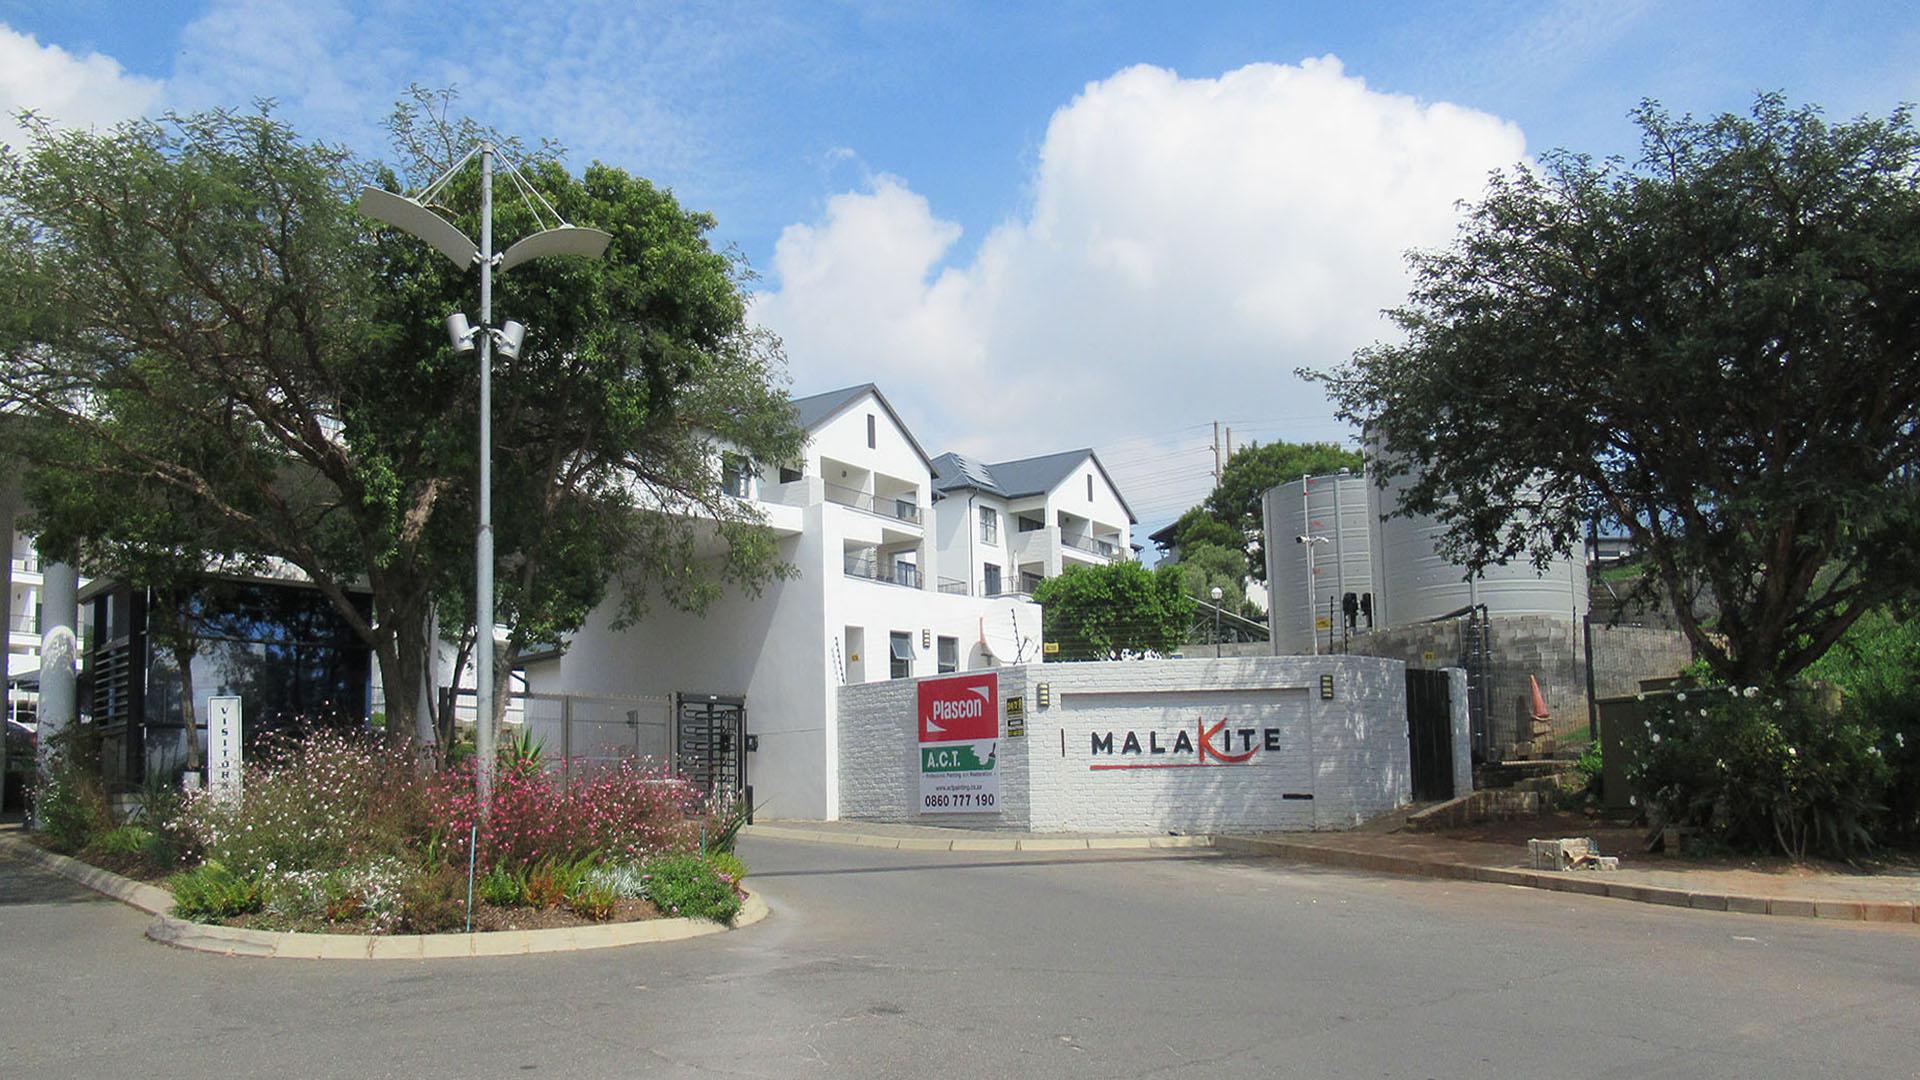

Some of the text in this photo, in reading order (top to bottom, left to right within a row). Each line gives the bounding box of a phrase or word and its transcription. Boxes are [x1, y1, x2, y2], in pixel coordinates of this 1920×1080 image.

[933, 699, 982, 720] Plascon
[1091, 716, 1281, 763] MALAKITE
[928, 751, 961, 768] A.C.T.
[925, 793, 995, 807] 0860 777 190
